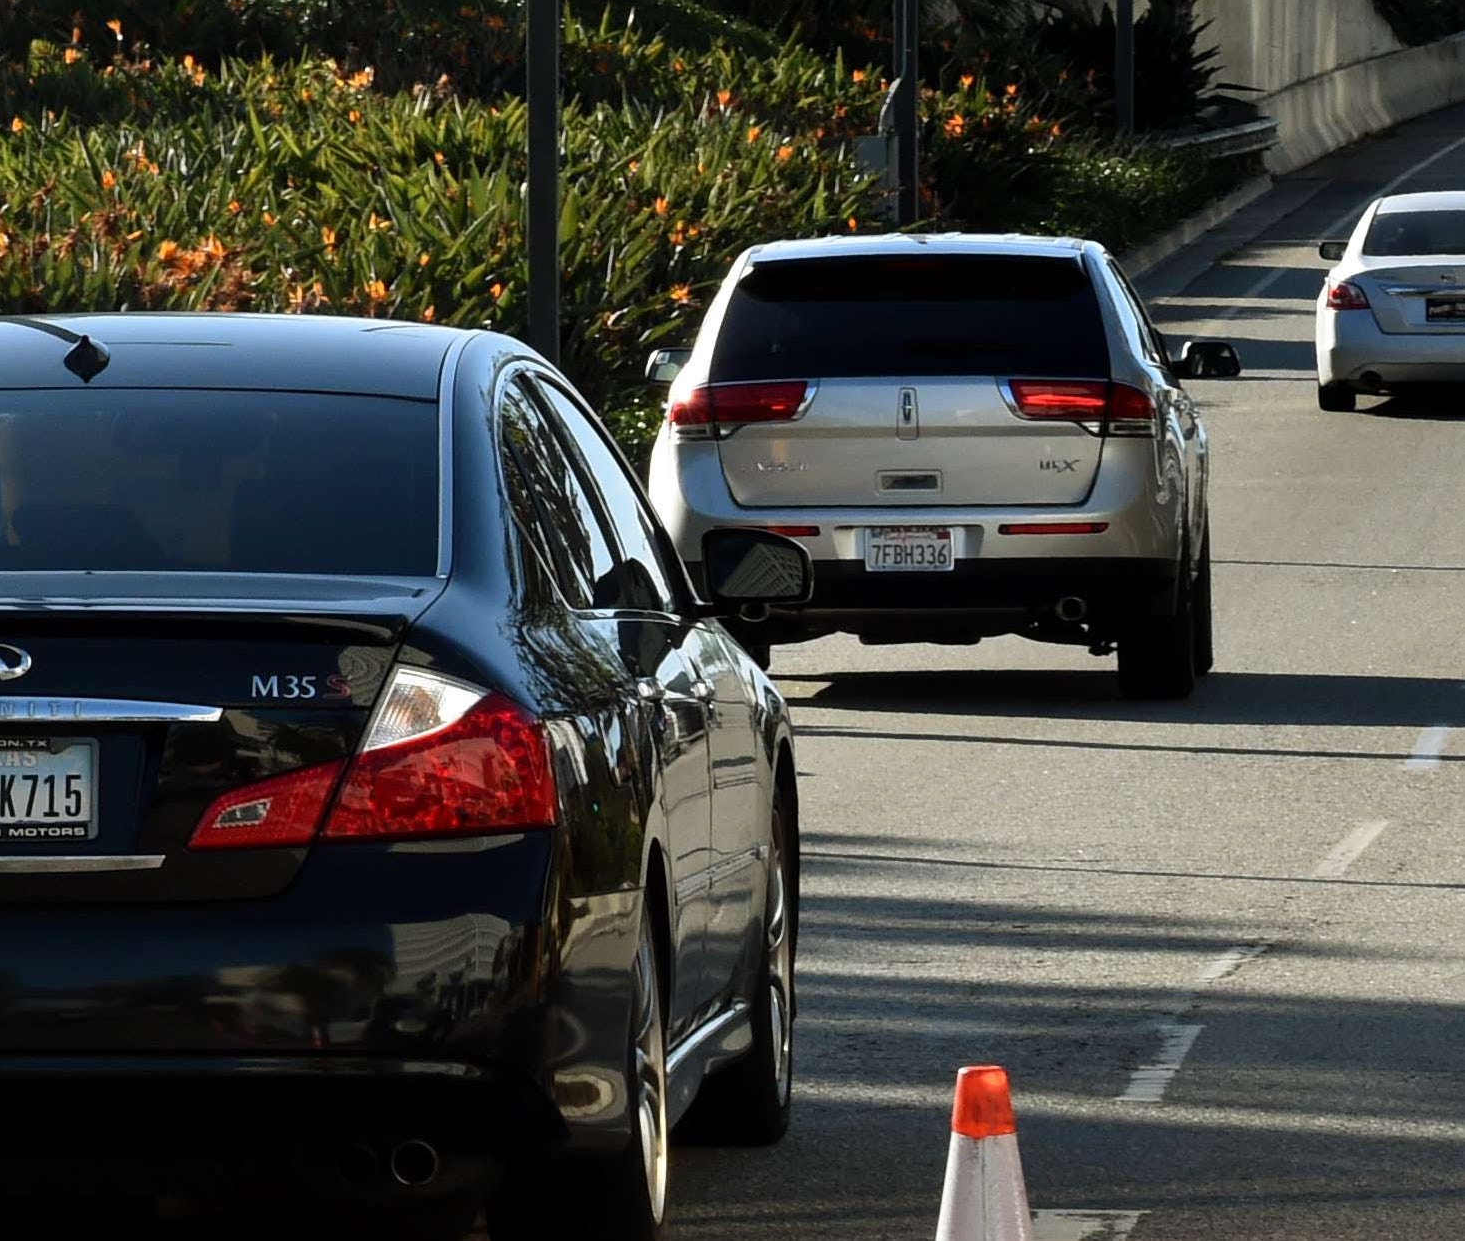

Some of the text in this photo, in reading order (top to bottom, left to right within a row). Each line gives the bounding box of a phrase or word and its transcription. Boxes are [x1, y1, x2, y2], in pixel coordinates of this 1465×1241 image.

[871, 544, 948, 565] 7FBH336
[251, 675, 318, 699] M35
[8, 826, 86, 838] MOTORS
